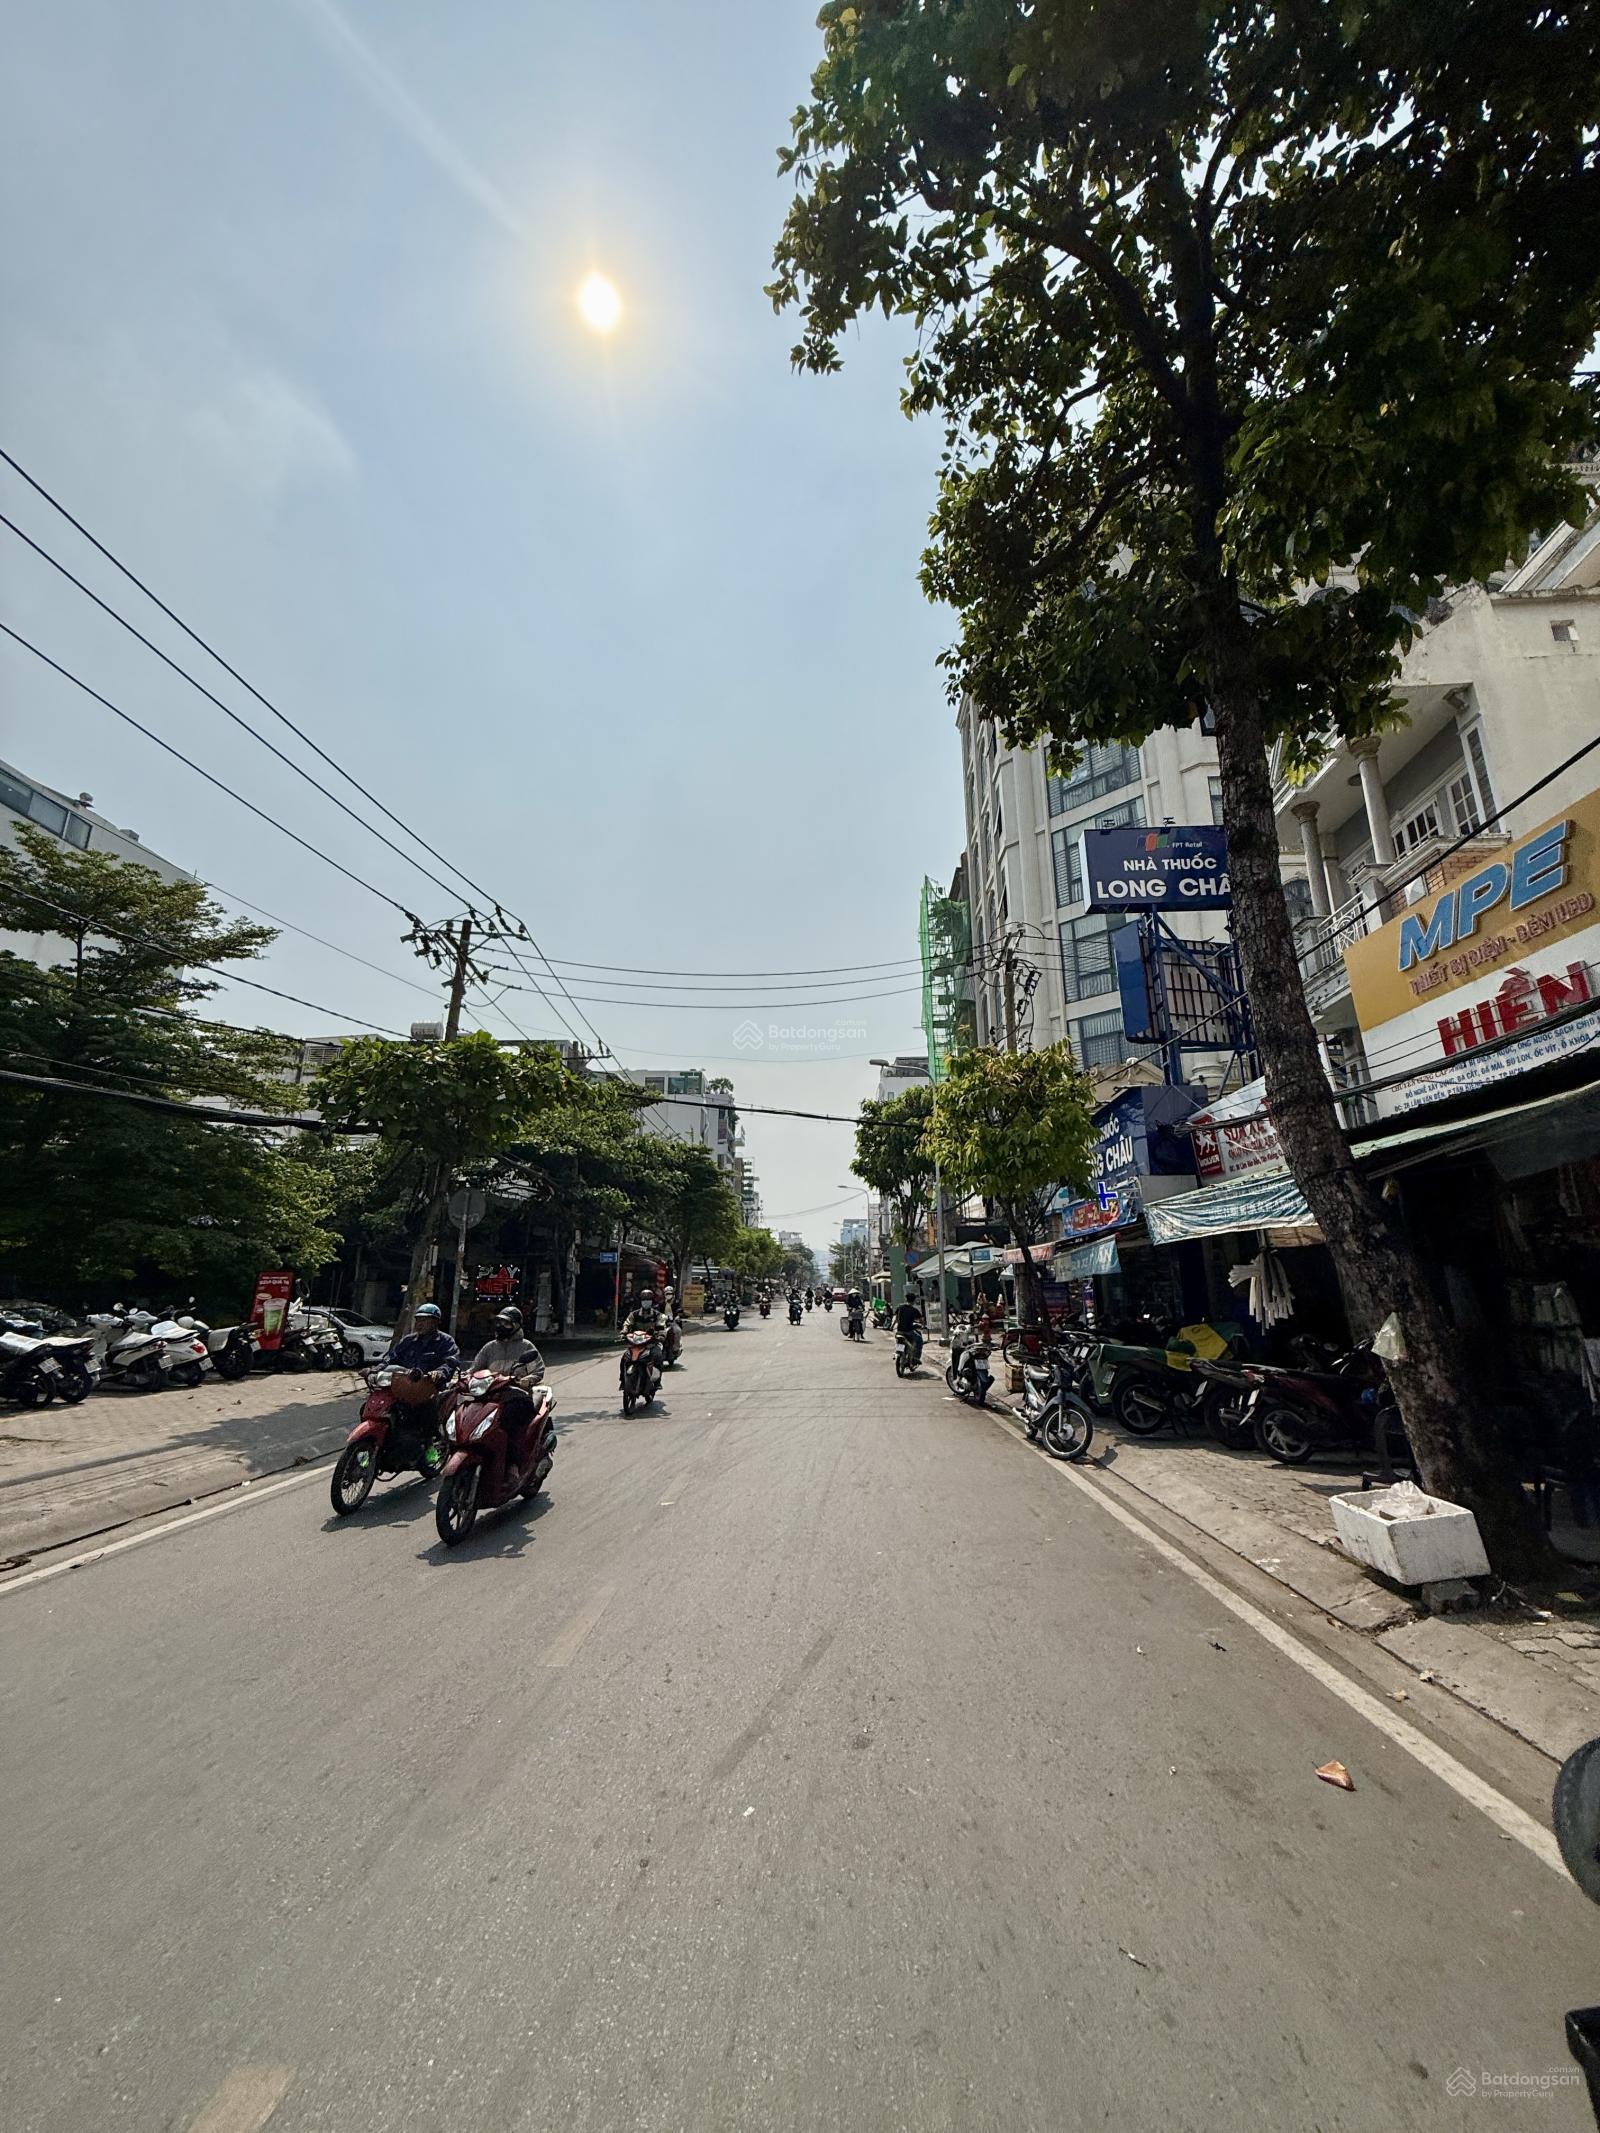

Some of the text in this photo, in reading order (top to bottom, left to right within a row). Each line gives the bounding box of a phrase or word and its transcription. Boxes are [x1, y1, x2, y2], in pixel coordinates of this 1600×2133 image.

[1185, 841, 1203, 849] Retail
[1123, 853, 1218, 872] NHÀ THUỐC
[1096, 872, 1232, 900] LONG CHÂ
[1398, 819, 1572, 973] MPE
[1437, 961, 1593, 1057] HIỀN
[1105, 1134, 1134, 1172] CHÂU
[479, 1266, 519, 1279] PLAY
[476, 1279, 518, 1295] NET
